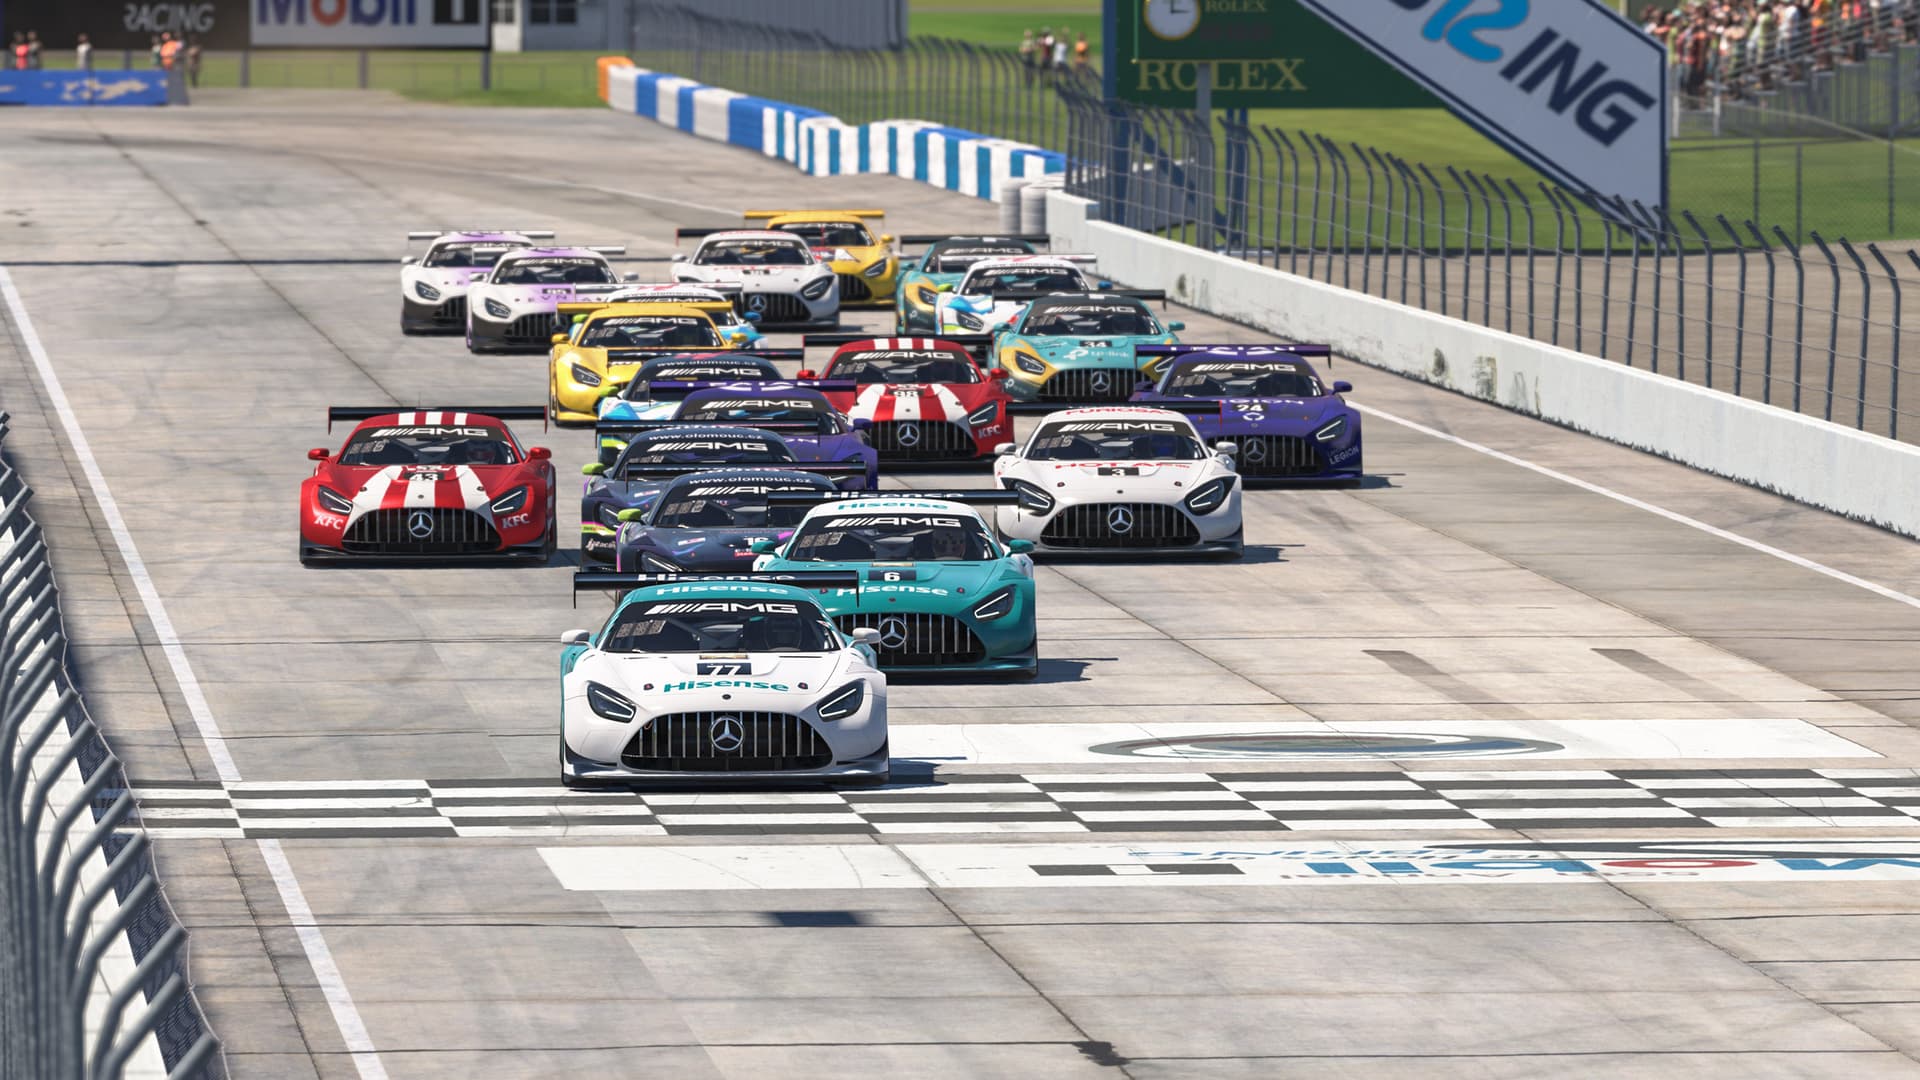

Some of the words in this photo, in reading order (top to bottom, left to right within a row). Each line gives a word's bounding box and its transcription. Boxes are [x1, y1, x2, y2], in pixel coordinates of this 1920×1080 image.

[1136, 58, 1307, 91] ROLEX
[637, 317, 698, 325] AMG
[886, 352, 955, 360] AMG
[694, 367, 762, 376] AMG
[1226, 364, 1297, 372] AMG
[736, 400, 814, 409] AMG
[1236, 404, 1264, 412] 24
[409, 427, 489, 437] AMG
[977, 424, 1002, 439] KFC
[1095, 422, 1176, 432] AMG
[687, 442, 768, 451] AMG
[409, 472, 439, 481] 43
[689, 475, 813, 485] www.olomouc.cz
[838, 502, 949, 510] Hisense
[313, 513, 344, 530] KFC
[502, 513, 530, 529] KFC
[868, 517, 961, 528] AMG
[637, 573, 796, 581] Hisense
[883, 571, 901, 582] 6
[656, 585, 790, 596] Hisense
[836, 583, 949, 597] Hisense
[699, 603, 799, 614] AMG
[706, 663, 742, 676] 77
[663, 680, 790, 693] Hisense
